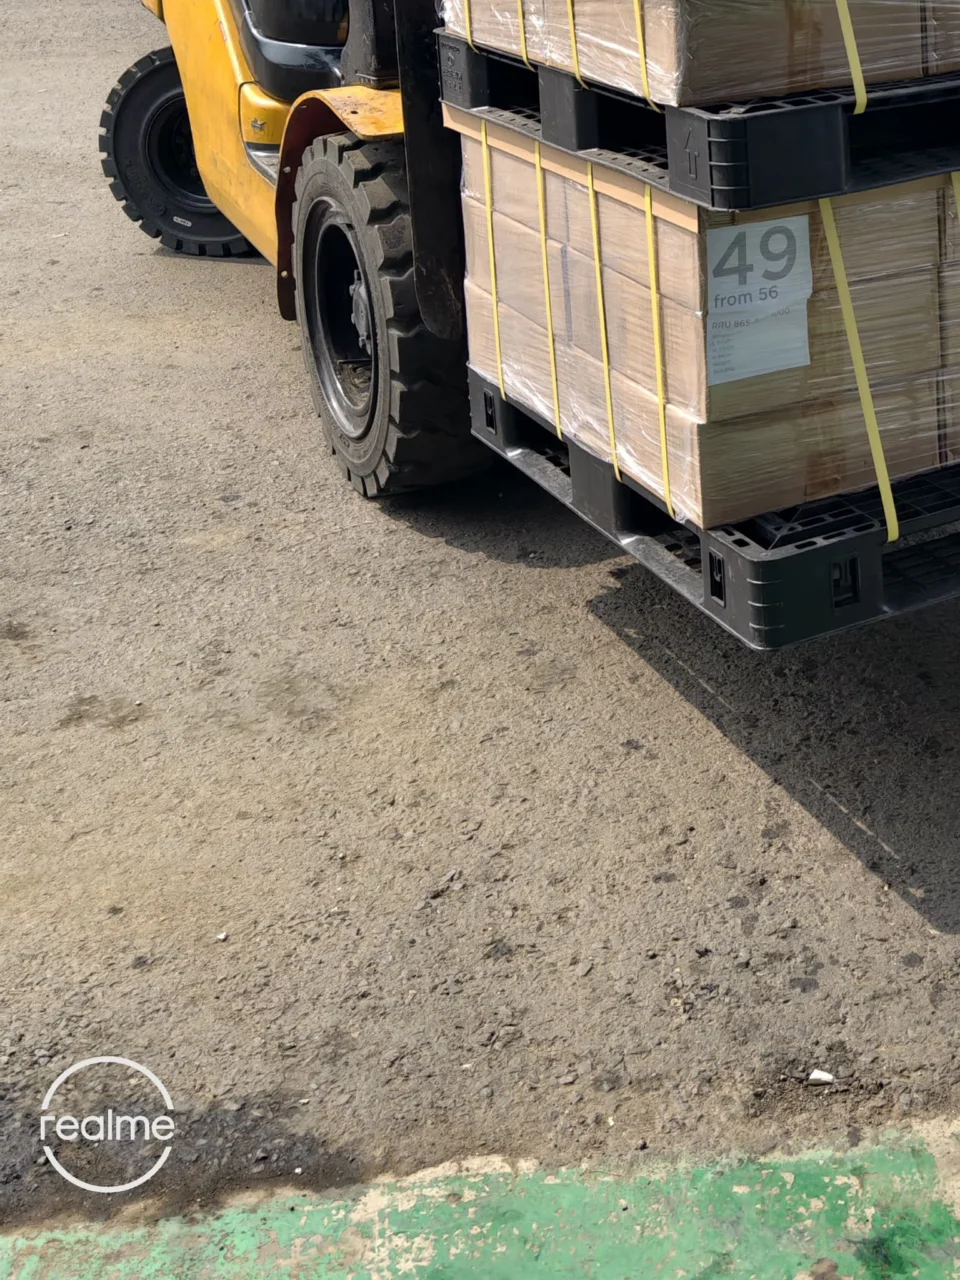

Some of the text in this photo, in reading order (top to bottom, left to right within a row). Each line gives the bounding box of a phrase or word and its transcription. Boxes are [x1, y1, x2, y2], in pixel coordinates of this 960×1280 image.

[712, 225, 797, 286] 49
[713, 285, 779, 309] from 56
